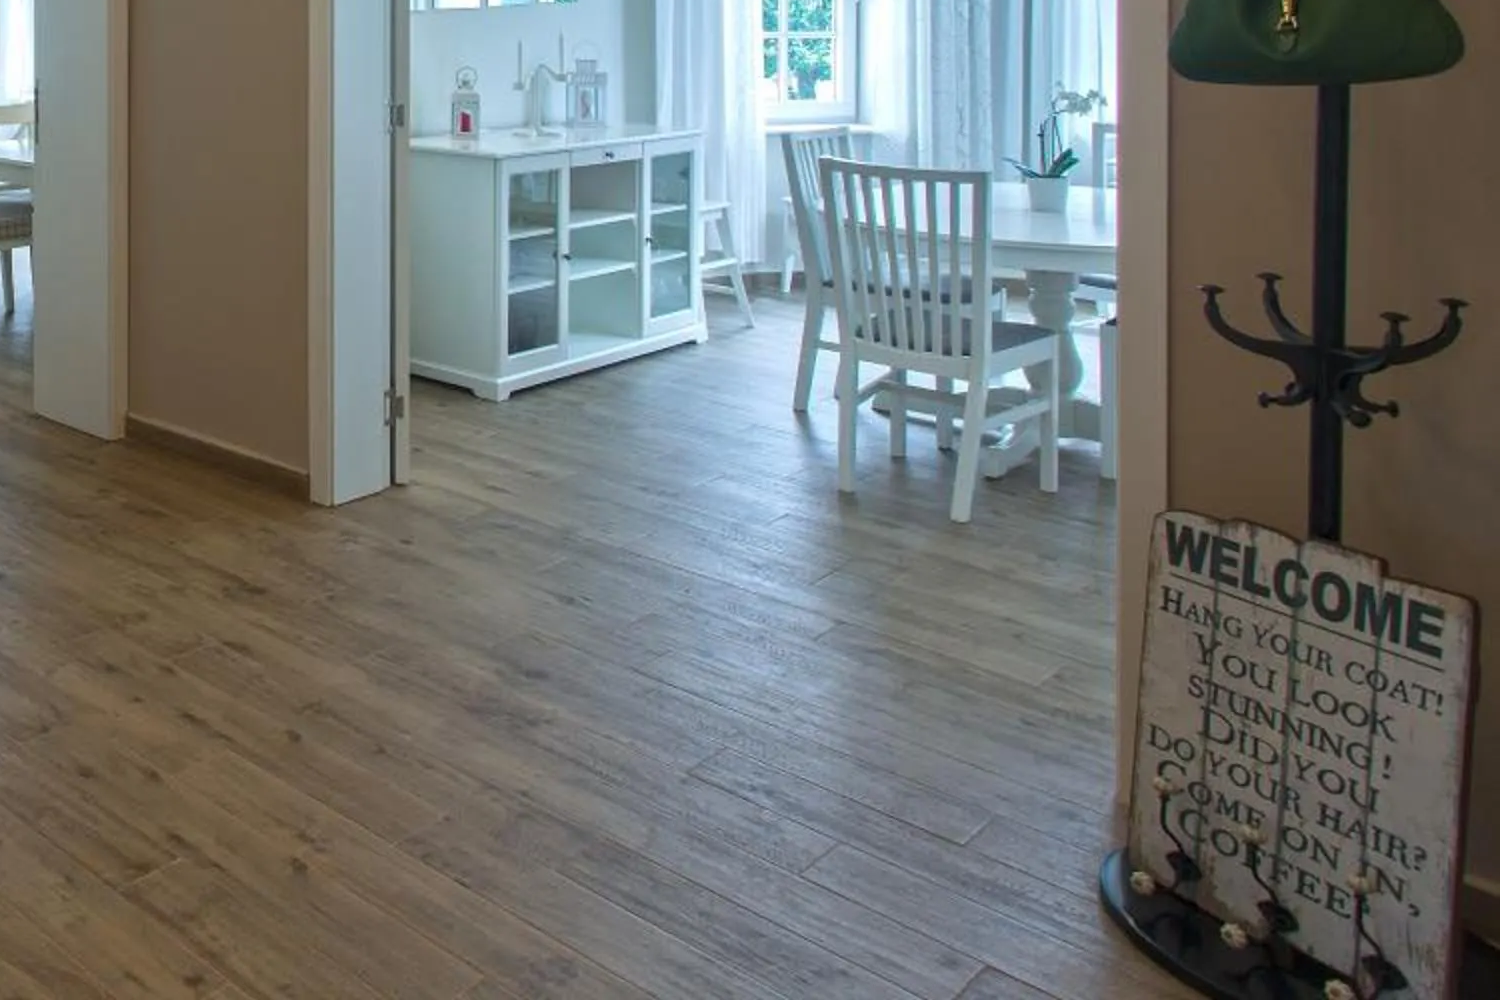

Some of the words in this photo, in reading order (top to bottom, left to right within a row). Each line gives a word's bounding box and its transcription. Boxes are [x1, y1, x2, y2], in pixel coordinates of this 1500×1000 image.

[1159, 585, 1244, 641] HANG
[1252, 624, 1335, 677] YOUR
[1345, 660, 1444, 717] COAT!
[1165, 520, 1446, 660] WELCOME
[1193, 631, 1278, 694] YOU
[1290, 678, 1397, 744] LOOK
[1146, 723, 1196, 762] DO
[1207, 750, 1305, 820] YOUR
[1315, 802, 1427, 872] HAIR?
[1156, 759, 1267, 830] COME
[1282, 826, 1340, 871] ON
[1291, 753, 1381, 814] YOU
